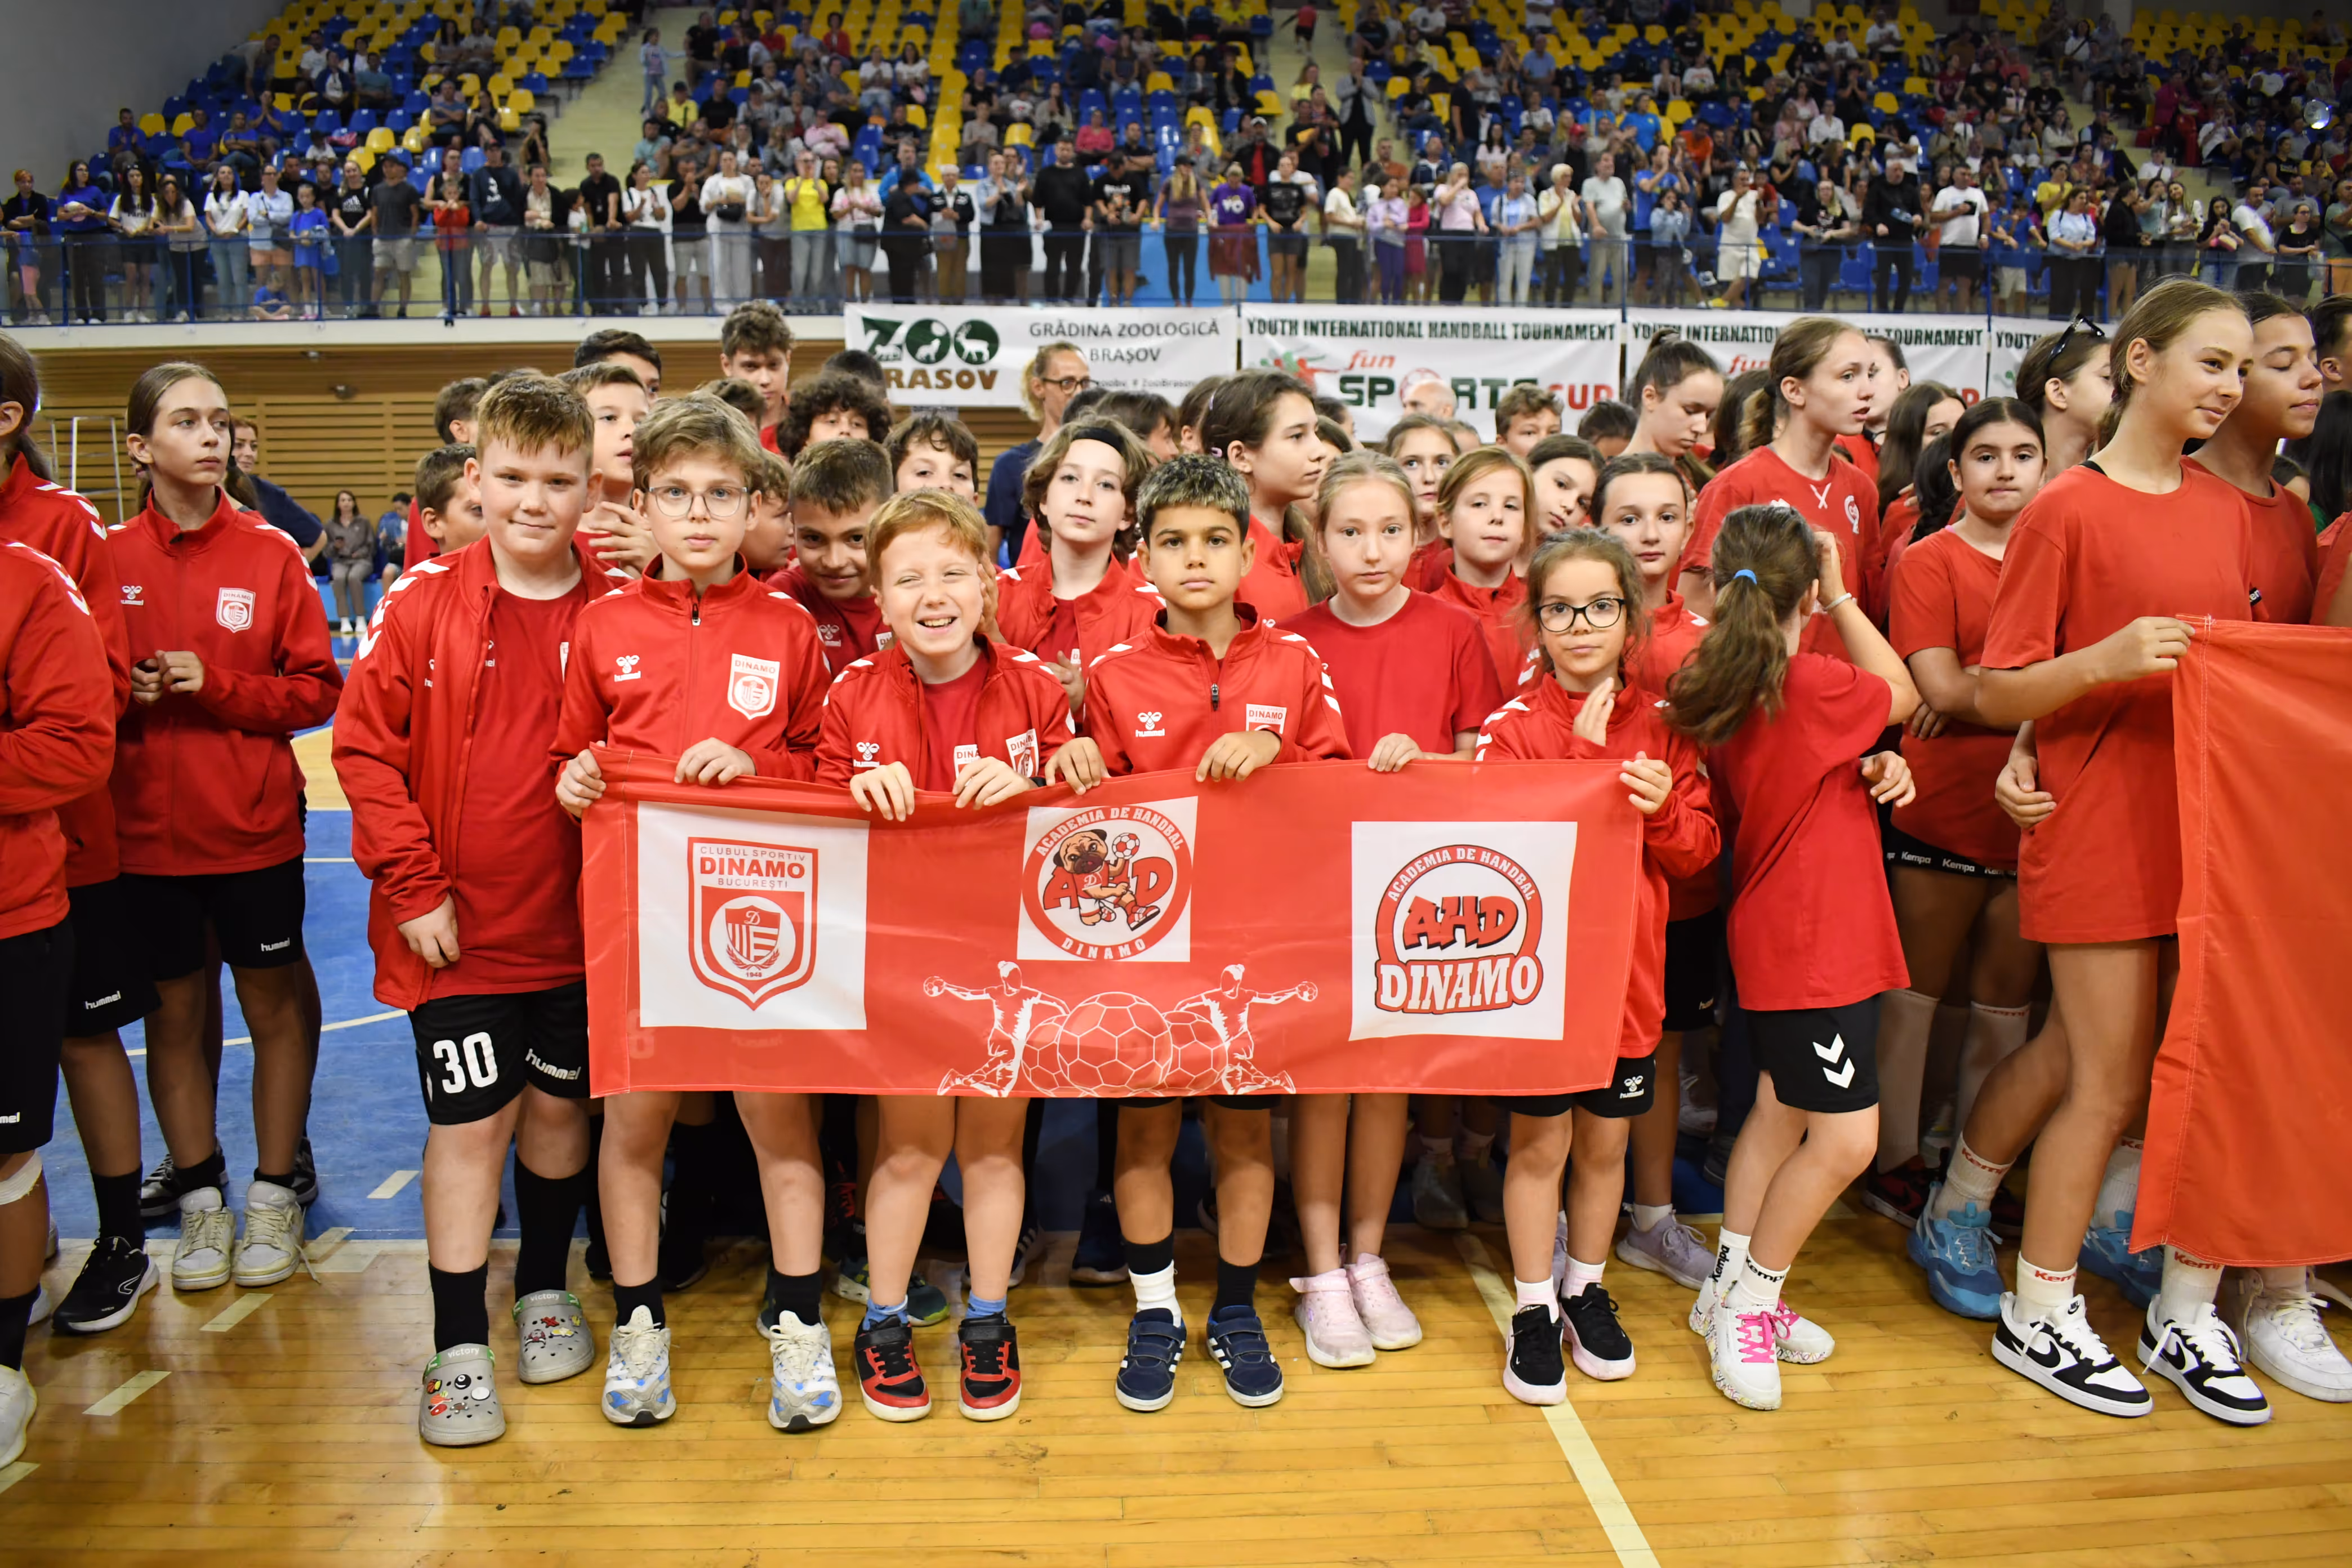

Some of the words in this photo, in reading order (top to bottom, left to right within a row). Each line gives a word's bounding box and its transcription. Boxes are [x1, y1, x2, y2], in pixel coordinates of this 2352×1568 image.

[1030, 318, 1112, 337] GRĂDINA
[1117, 317, 1220, 336] ZOOLOGICĂ
[1247, 318, 1298, 336] YOUTH
[1304, 320, 1423, 338] INTERNATIONAL
[1429, 321, 1507, 340] HANDBALL
[1512, 322, 1616, 340] TOURNAMENT
[1686, 324, 1780, 342] INTERNATIO
[862, 316, 999, 364] ZOO
[1090, 348, 1161, 365] BRAȘOV
[1344, 349, 1396, 371] fun
[884, 367, 999, 390] RASOV
[223, 592, 251, 601] DINAMO
[734, 659, 776, 674] DINAMO
[1249, 710, 1283, 720] DINAMO
[1035, 809, 1105, 856] ACADEMIA
[1110, 807, 1129, 819] DE
[1133, 808, 1184, 851] HANDBAL
[700, 847, 749, 856] CLUBUL
[752, 849, 805, 861] SPORTIV
[1901, 852, 1931, 865] Kempa
[1943, 858, 1975, 872] Kempa
[700, 857, 805, 879] DINAMO
[1388, 848, 1451, 902] ACADEMIA
[1456, 848, 1476, 860] DE
[1480, 850, 1535, 901] HANDBAL
[718, 877, 788, 890] BUCUREȘTI
[1402, 895, 1519, 951] AHD
[261, 937, 290, 952] hummel
[1062, 937, 1146, 959] DINAMO
[1380, 955, 1538, 1011] DINAMO
[86, 990, 121, 1010] hummel
[433, 1031, 498, 1094] 30
[525, 1048, 581, 1080] hummel
[1709, 1245, 1730, 1282] Kempa
[1746, 1256, 1784, 1282] Kemp
[531, 1293, 560, 1302] victory
[448, 1347, 480, 1358] victory
